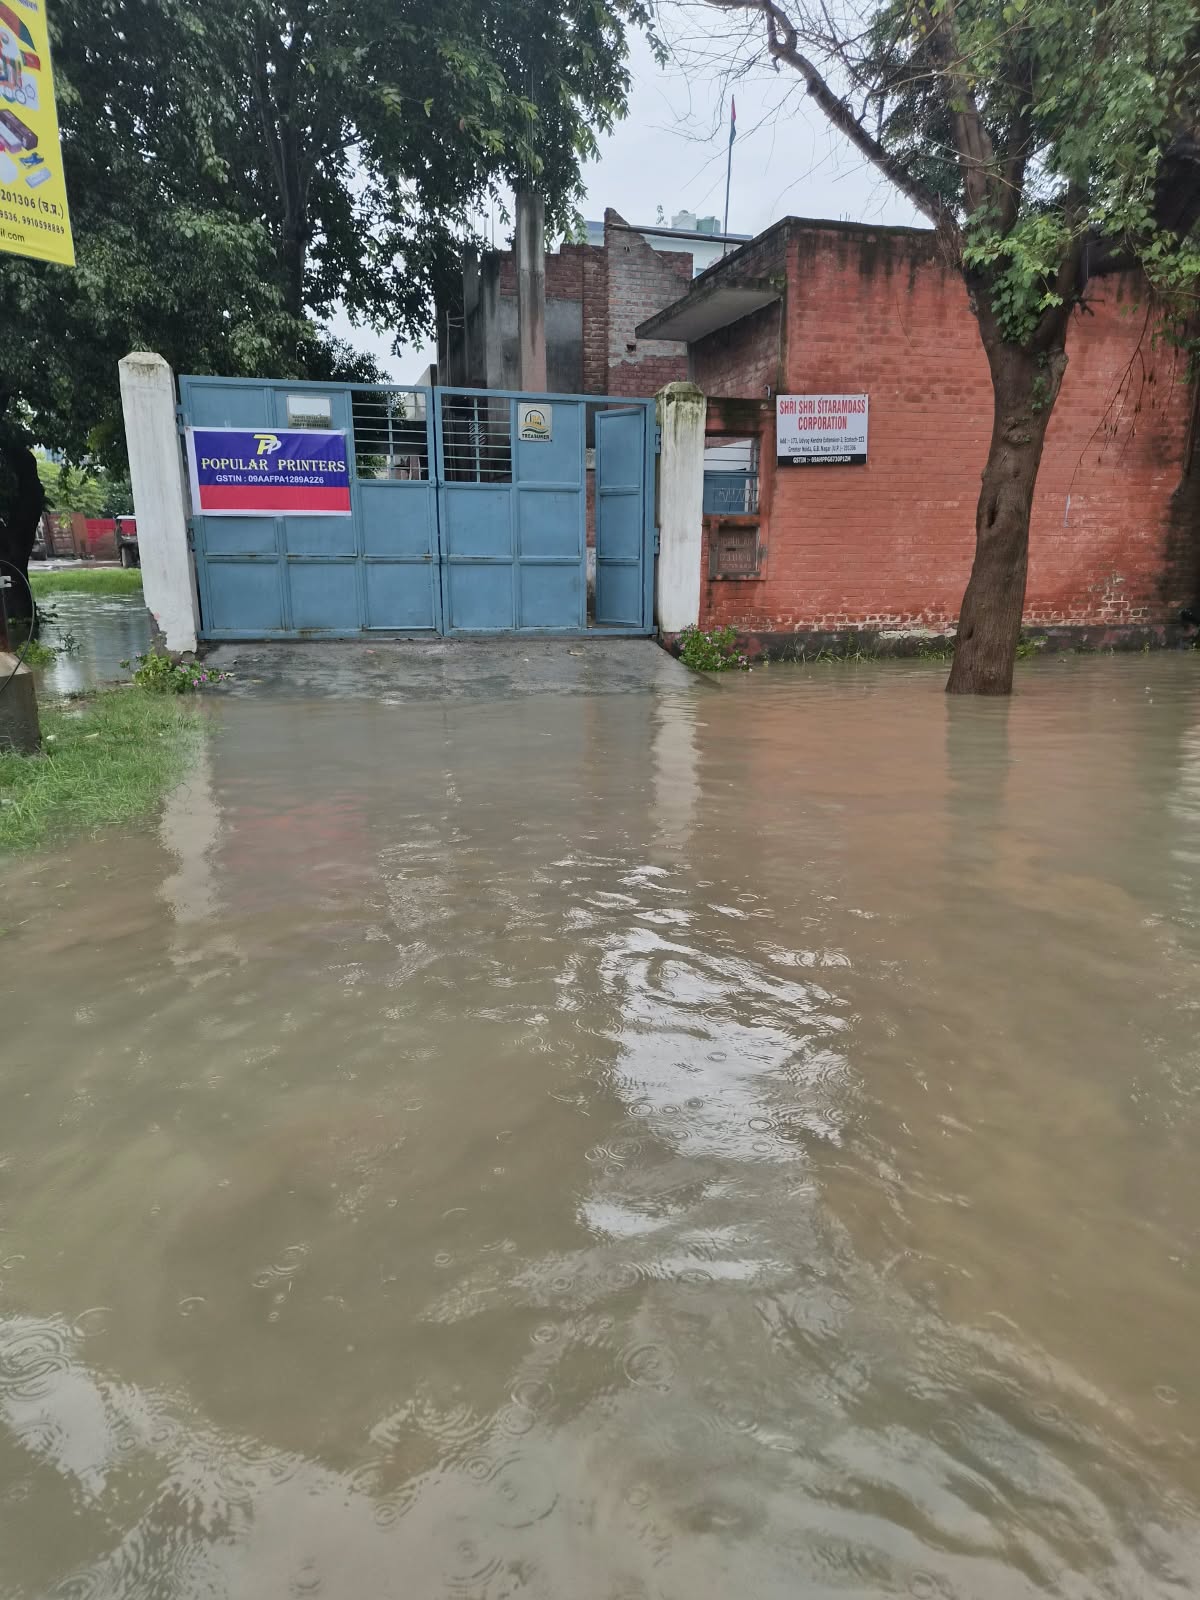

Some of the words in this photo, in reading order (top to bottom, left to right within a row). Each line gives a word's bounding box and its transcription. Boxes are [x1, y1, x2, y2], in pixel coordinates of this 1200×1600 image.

[780, 400, 796, 414] SHRI
[798, 400, 816, 414] SHRI
[818, 400, 866, 414] SITARAMDASS
[798, 416, 848, 430] CORPORATION
[201, 458, 269, 472] POPULAR
[278, 459, 346, 472] PRINTERS
[216, 474, 242, 482] GSTIN
[248, 475, 324, 484] 09AAFPA1289A2Z6
